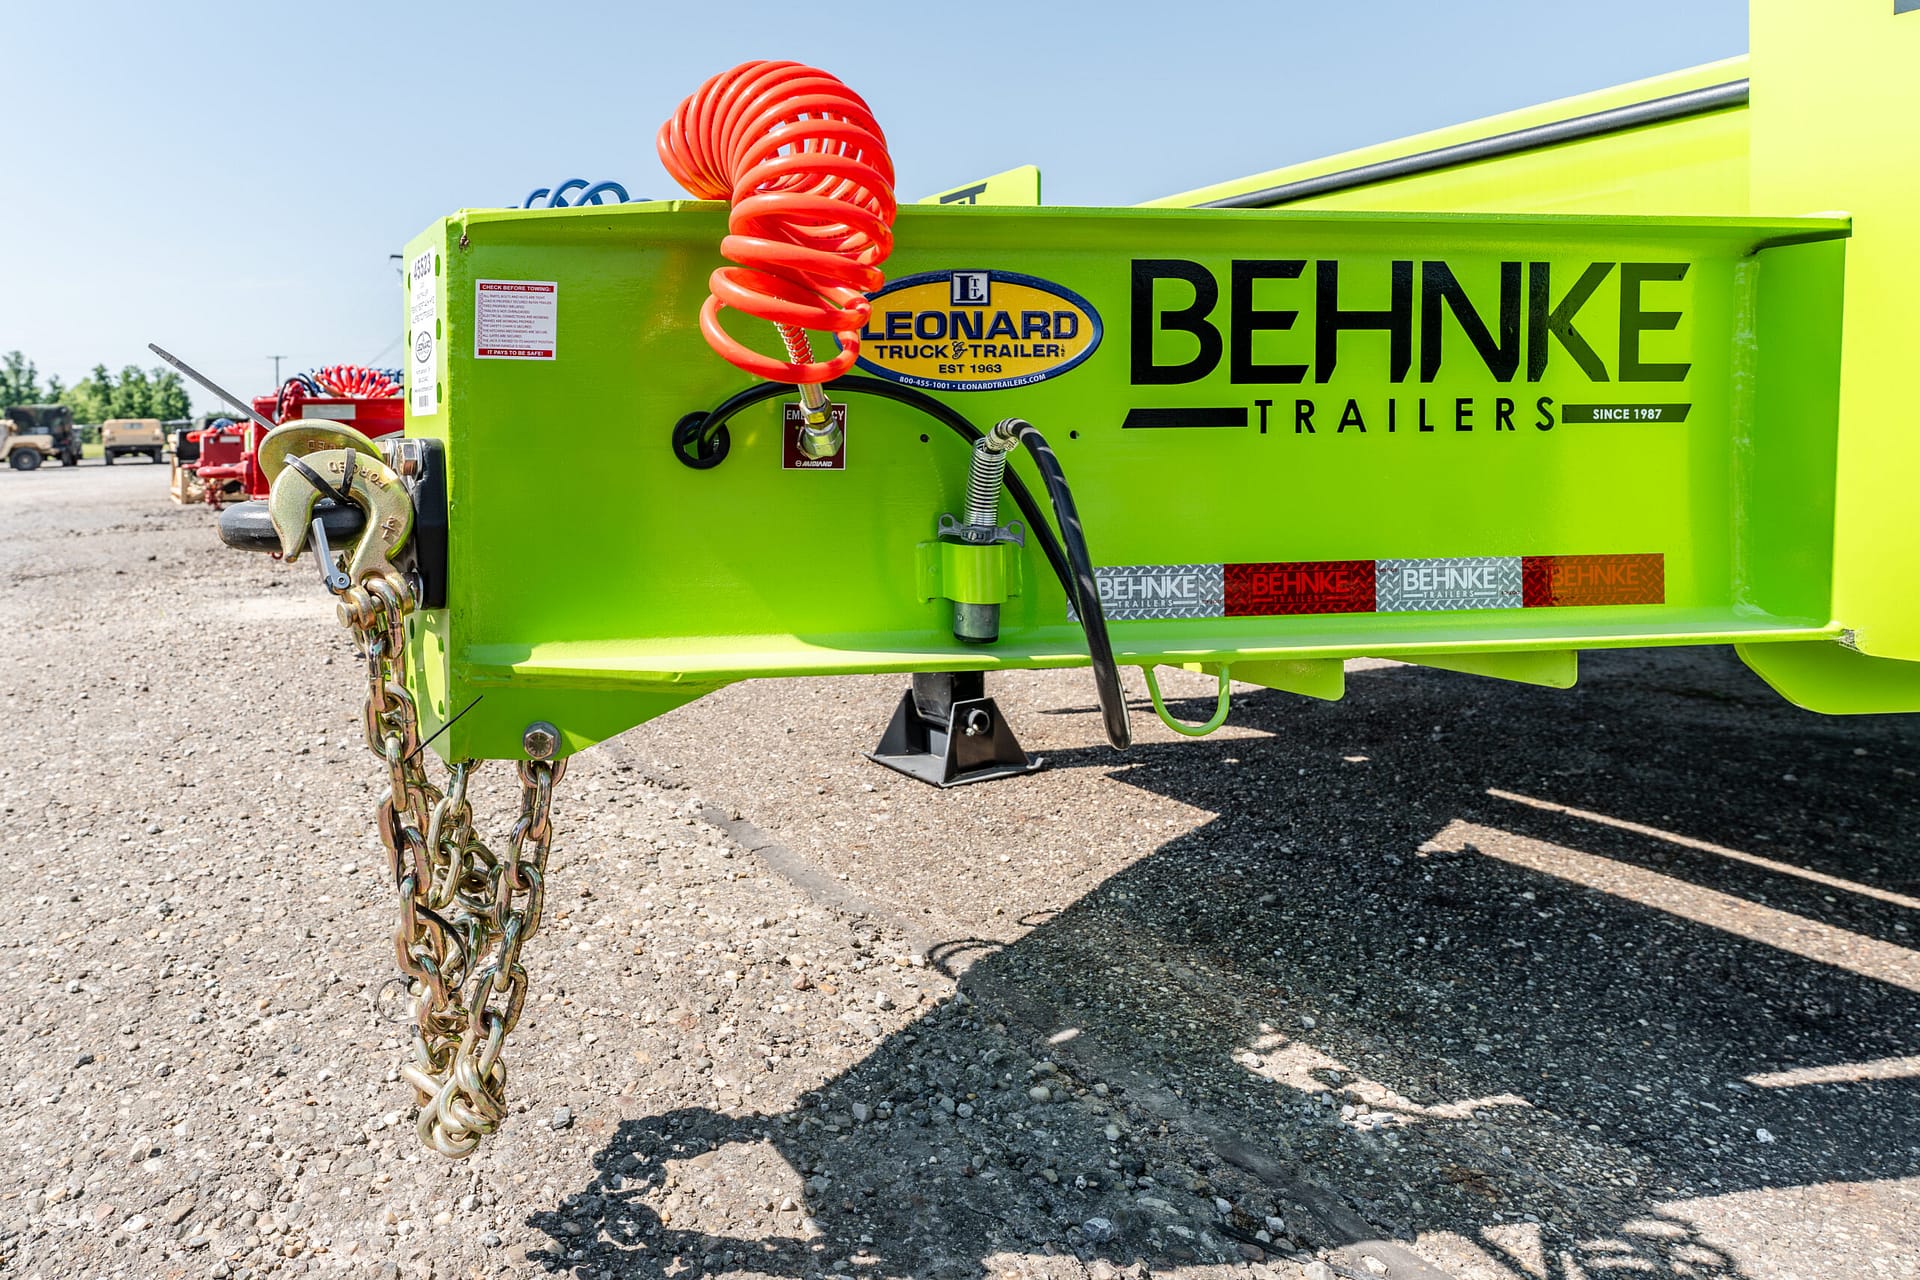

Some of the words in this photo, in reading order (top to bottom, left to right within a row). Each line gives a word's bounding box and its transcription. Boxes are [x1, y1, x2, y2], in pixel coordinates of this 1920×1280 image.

[413, 252, 431, 280] 45523
[861, 310, 1078, 340] LEONARD
[1130, 259, 1692, 385] BEHNKE
[874, 344, 948, 359] TRUCK
[968, 343, 1059, 358] TRAILER
[938, 363, 964, 374] EST
[970, 363, 1002, 374] 1963
[899, 375, 950, 389] 800-455-1001
[957, 372, 1047, 390] LEONARDTRAILERS.COM
[1254, 396, 1555, 434] TRAILERS
[1592, 408, 1630, 420] SINCE
[1633, 408, 1662, 420] 1987
[1252, 571, 1350, 595] BEHNKE
[1402, 567, 1497, 591] BEHNKE
[1551, 563, 1640, 587] BEHNKE
[1096, 575, 1198, 600] BEHNKE
[1423, 590, 1475, 599] TRAILERS
[1117, 599, 1173, 608] TRAILERS
